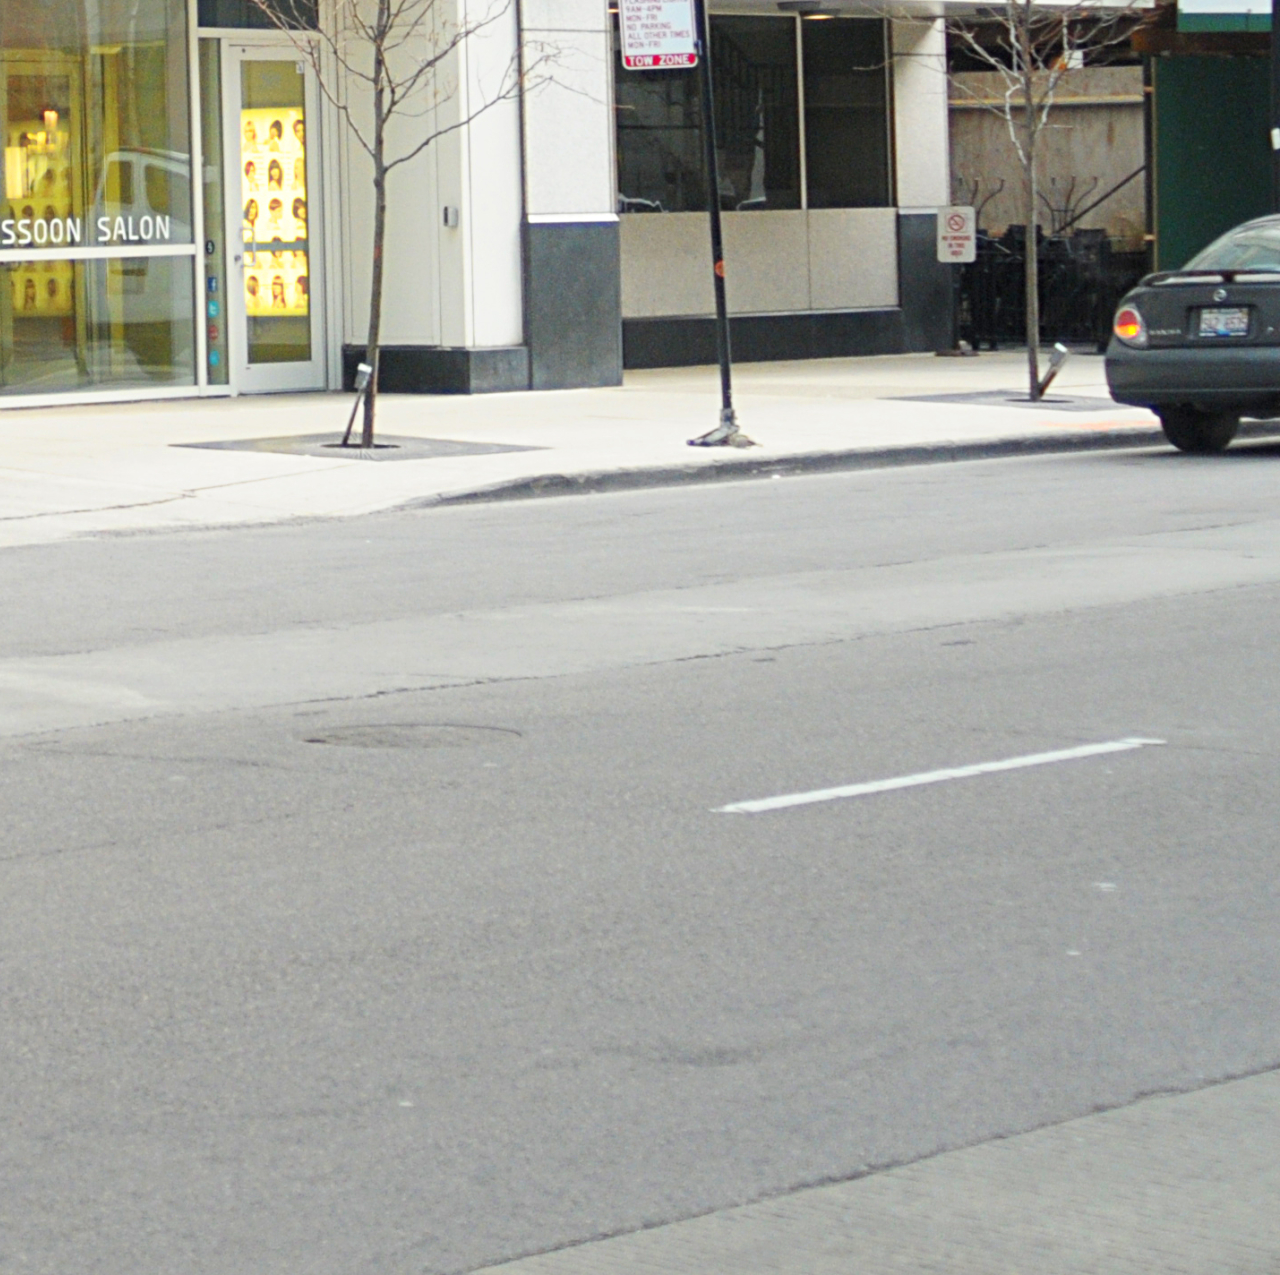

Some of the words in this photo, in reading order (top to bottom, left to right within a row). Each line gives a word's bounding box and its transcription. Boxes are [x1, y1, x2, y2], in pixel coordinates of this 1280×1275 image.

[626, 23, 637, 31] NO
[640, 21, 672, 30] PARKING
[628, 31, 642, 40] ALL
[643, 30, 668, 39] OTHER
[670, 29, 690, 38] TIMES
[628, 56, 654, 67] TOW
[658, 54, 689, 65] ZONE
[96, 214, 171, 242] SALON
